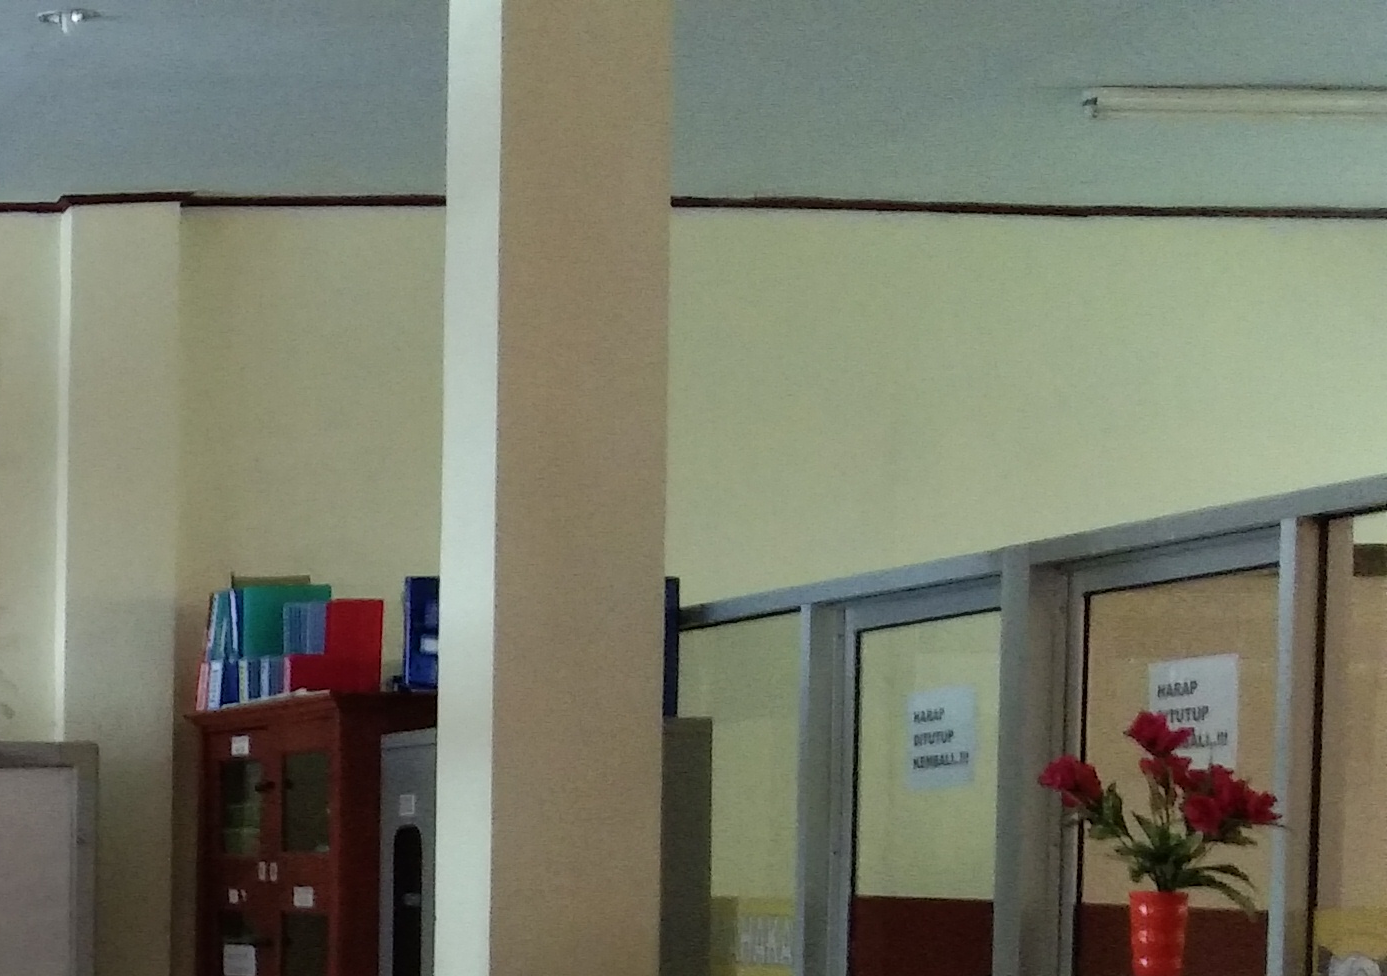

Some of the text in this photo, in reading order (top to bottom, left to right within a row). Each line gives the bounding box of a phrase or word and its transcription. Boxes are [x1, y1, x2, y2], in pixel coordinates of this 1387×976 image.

[1157, 680, 1198, 698] HARAP
[913, 708, 944, 723] HARAP
[1158, 705, 1209, 723] TUTUP
[914, 730, 953, 746] DITUTUP
